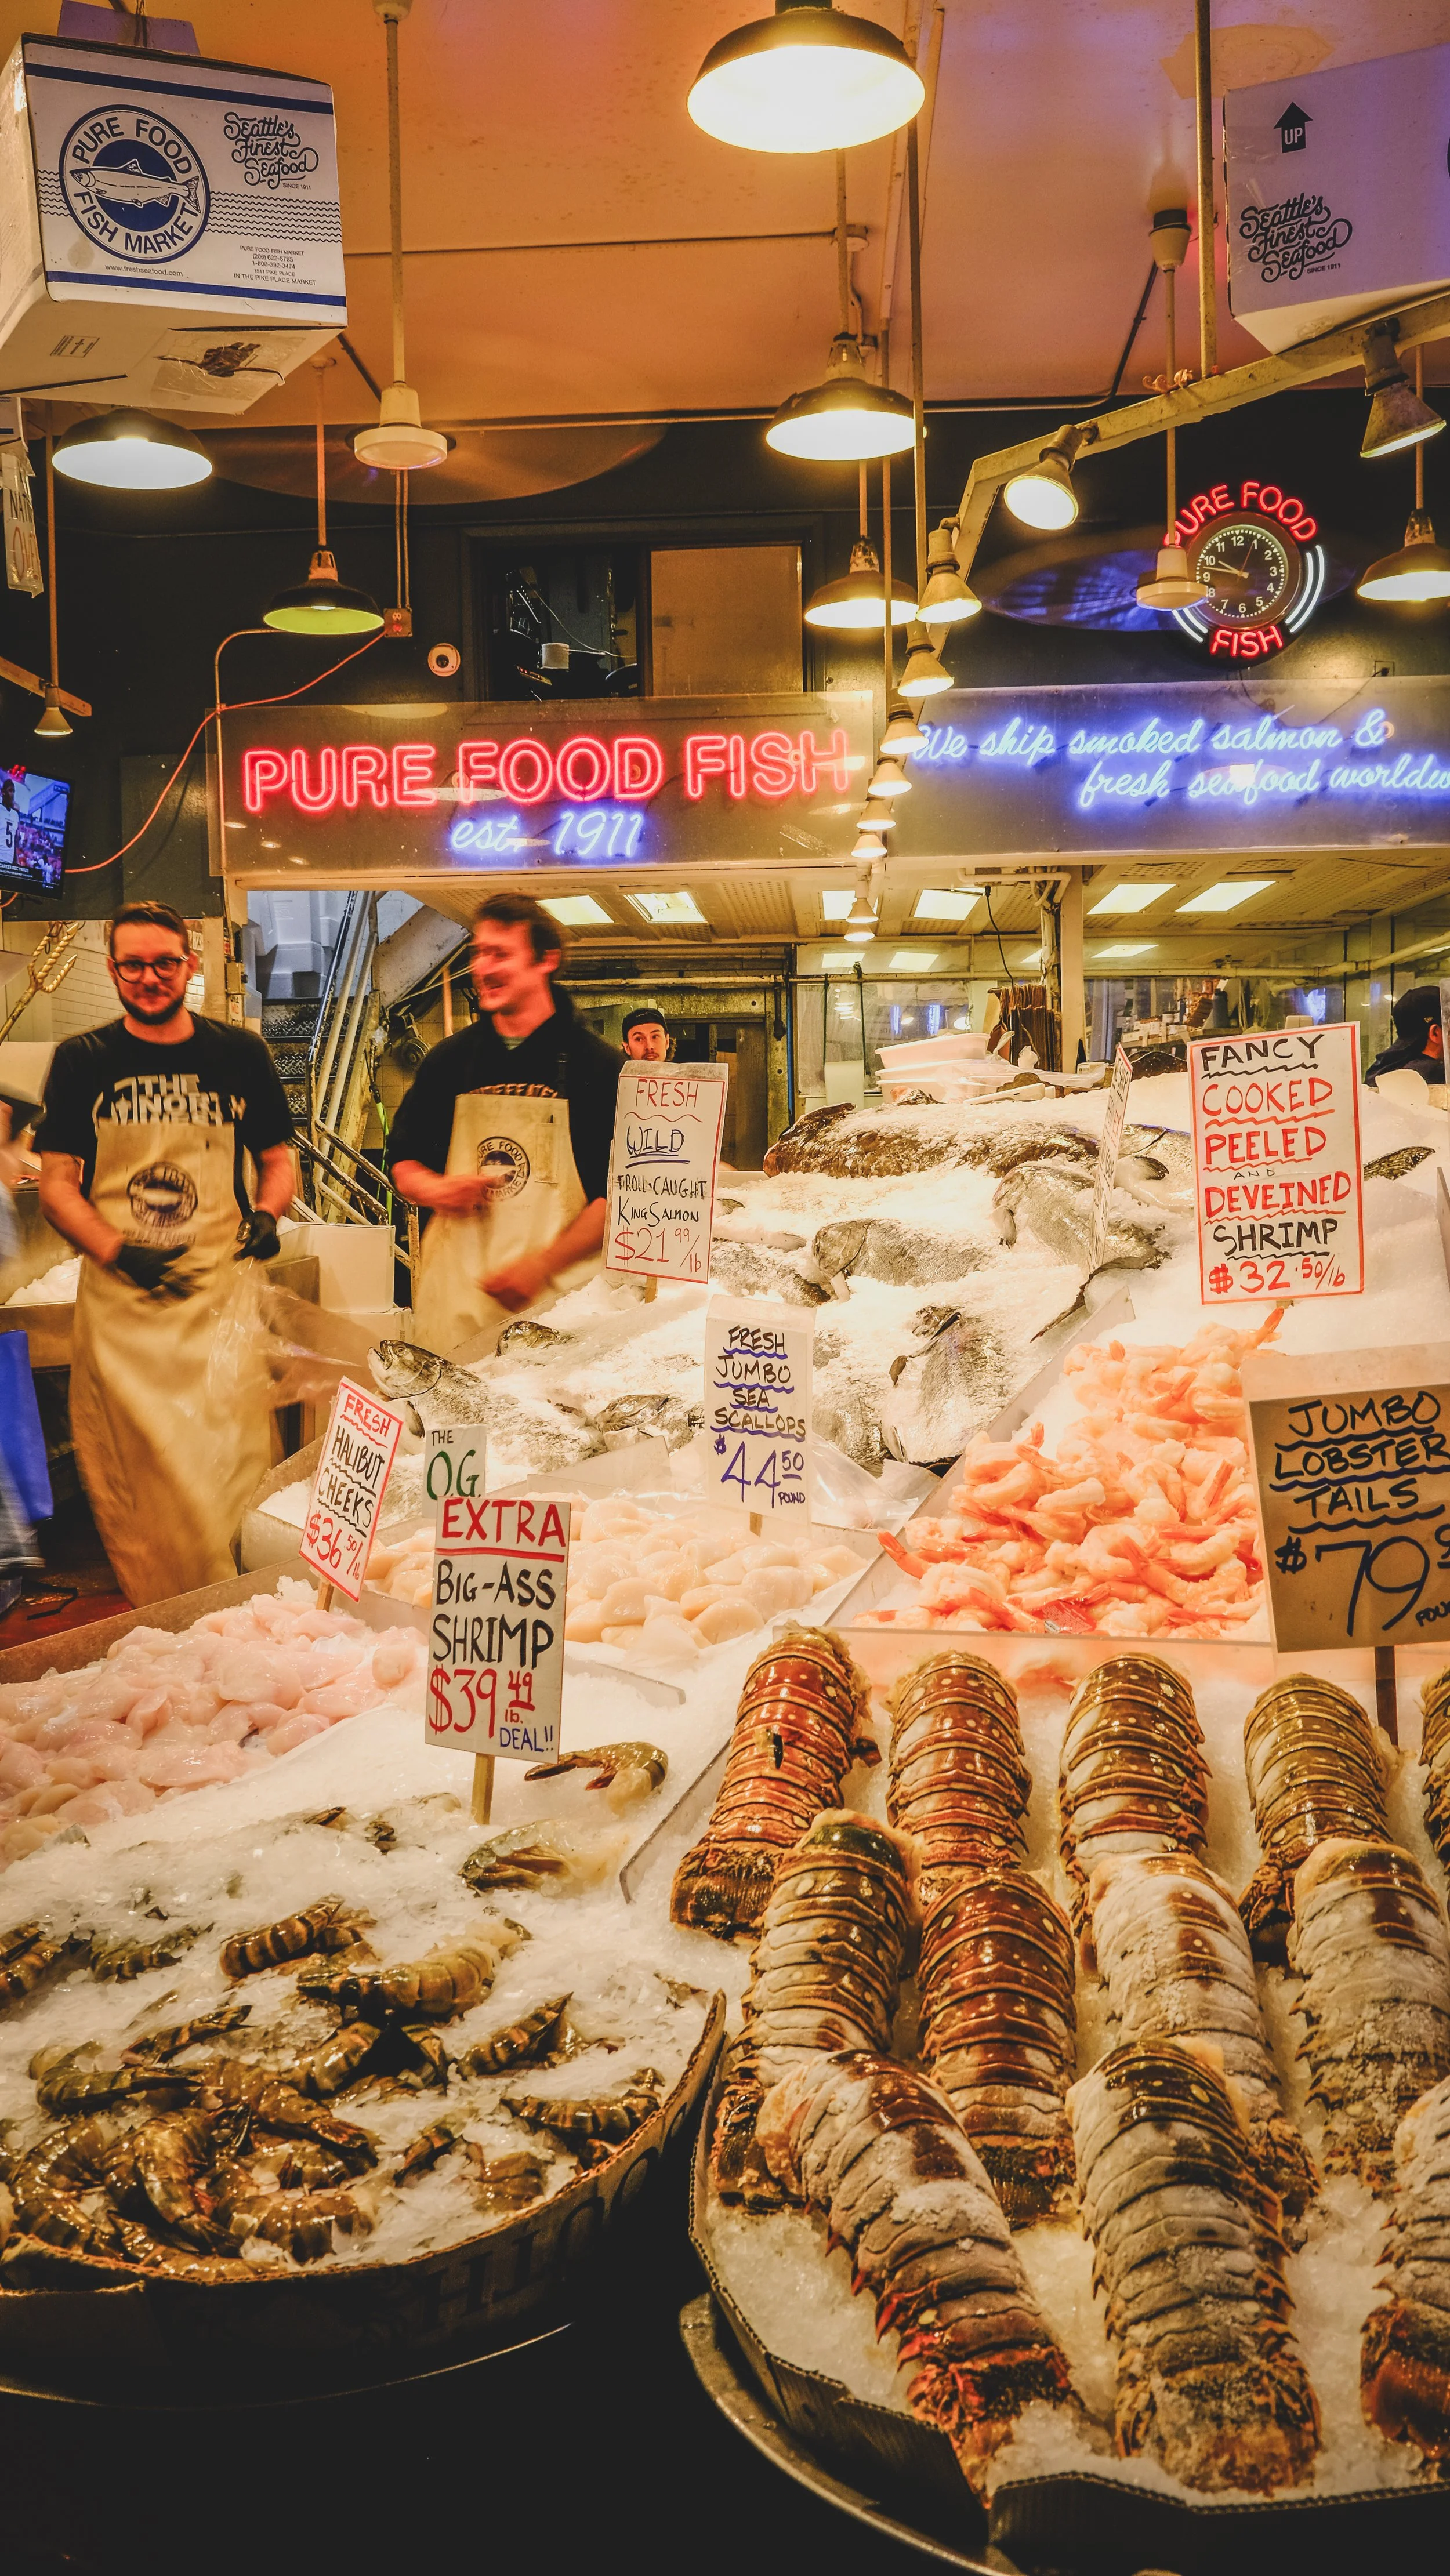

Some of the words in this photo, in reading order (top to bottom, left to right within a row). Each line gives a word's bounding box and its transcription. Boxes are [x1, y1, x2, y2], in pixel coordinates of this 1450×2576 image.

[223, 111, 295, 140] Seattle's
[1284, 127, 1303, 145] UP
[72, 116, 124, 164] PURE
[136, 118, 193, 174] FOOD
[231, 133, 301, 164] Finest
[244, 147, 319, 190] Seafood
[74, 191, 119, 242] FISH
[125, 201, 198, 255] MARKET
[1239, 192, 1324, 239] Seattle's
[1248, 206, 1331, 263] Finest
[1262, 217, 1353, 283] Seafood
[104, 264, 183, 277] www.freshseafood.com
[252, 261, 295, 269] 1-800-392-3474
[1307, 265, 1326, 274] SINCE
[1327, 263, 1341, 271] 1911
[1241, 481, 1317, 541] FOOD
[1216, 542, 1225, 552] 11
[1231, 536, 1245, 546] 12
[1252, 539, 1258, 550] 1
[1264, 550, 1273, 560] 2
[1205, 555, 1216, 566] 10
[1270, 567, 1278, 576] 3
[1203, 572, 1211, 582] 9
[1208, 587, 1216, 598] 8
[1266, 582, 1274, 593] 4
[1221, 599, 1229, 609] 7
[1238, 603, 1246, 614] 6
[1256, 596, 1263, 607] 5
[1210, 625, 1284, 658] FISH
[913, 725, 969, 760] We
[979, 717, 1056, 767] ship
[1068, 717, 1205, 754] smoked
[1211, 715, 1342, 751] salmon
[1354, 708, 1386, 748] &
[244, 745, 438, 811] PURE
[458, 737, 662, 803] FOOD
[686, 728, 849, 797] FISH
[1079, 759, 1172, 808] fresh
[1188, 757, 1322, 805] seafood
[5, 821, 13, 848] 5
[554, 811, 642, 857] 1911
[1201, 1033, 1325, 1072] FANCY
[636, 1079, 699, 1108] FRESH
[1202, 1077, 1333, 1116] COOKED
[499, 1141, 523, 1161] FOOD
[626, 1125, 685, 1156] WILD
[1205, 1126, 1327, 1166] PEELED
[1234, 1169, 1275, 1180] AND
[1204, 1171, 1351, 1218] DEVEINED
[1213, 1218, 1338, 1257] SHRIMP
[728, 1325, 785, 1355] FRESH
[715, 1355, 791, 1384] JUMBO
[732, 1389, 770, 1407] SEA
[343, 1393, 392, 1438] FRESH
[714, 1407, 806, 1438] SCALLOPS
[1288, 1391, 1441, 1438] JUMBO
[431, 1430, 454, 1446] THE
[331, 1425, 386, 1489] HALIBUT
[1275, 1432, 1450, 1481] LOBSTER
[317, 1467, 375, 1529] CHEEKS
[778, 1492, 806, 1505] POUND
[1293, 1478, 1419, 1518] TAILS
[442, 1497, 567, 1548] EXTRA
[432, 1613, 555, 1670] SHRIMP
[428, 1663, 498, 1739] $39
[499, 1725, 554, 1753] DEAL!!
